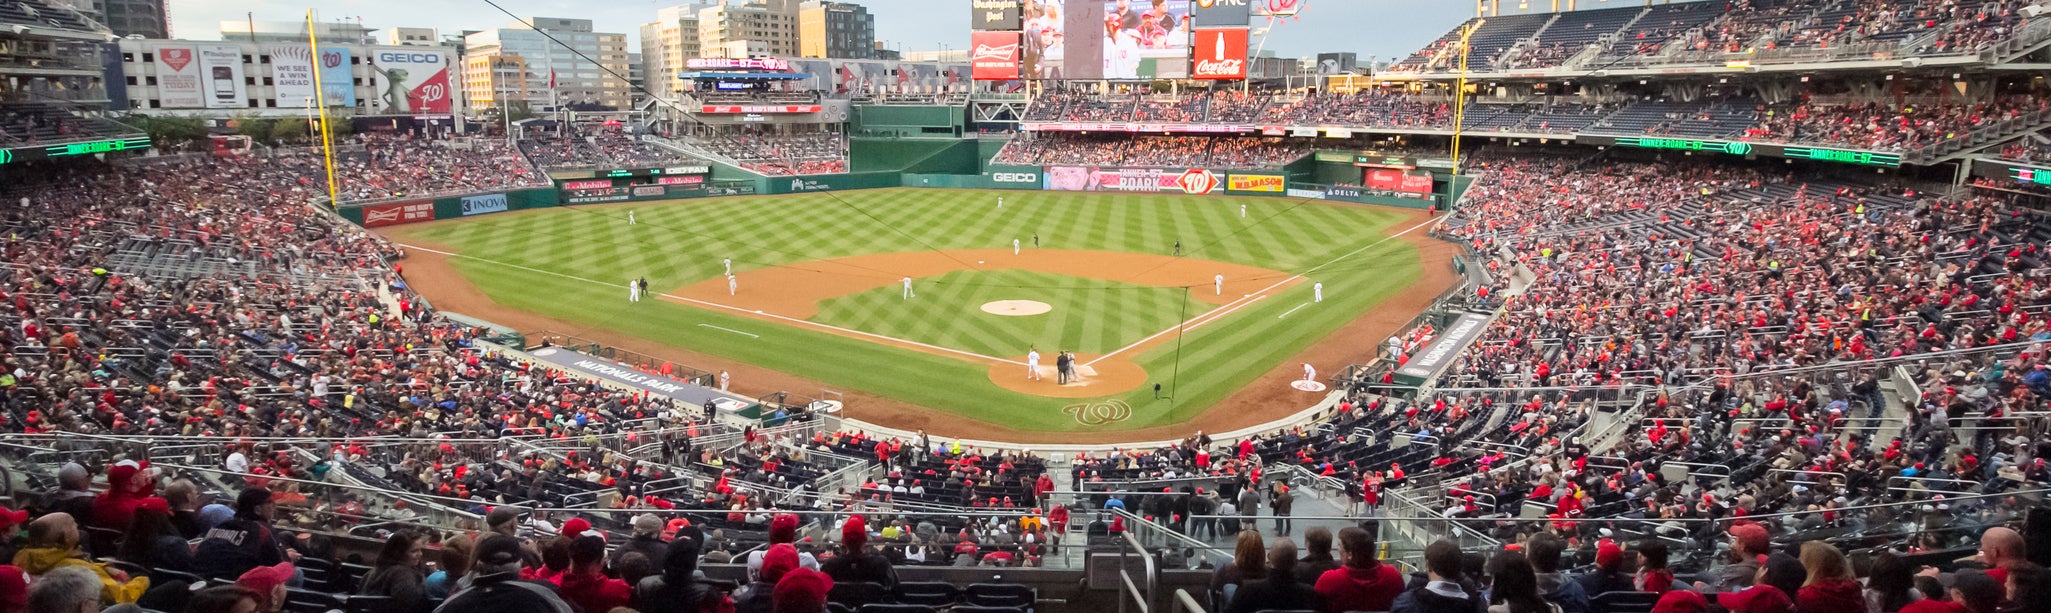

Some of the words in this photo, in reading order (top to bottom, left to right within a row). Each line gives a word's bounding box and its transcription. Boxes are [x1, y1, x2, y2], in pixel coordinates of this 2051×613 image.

[380, 53, 439, 63] GEICO
[1195, 59, 1242, 75] Coca-Cola
[1692, 141, 1703, 150] 57
[1860, 153, 1872, 163] 57
[993, 172, 1036, 183] GEICO
[1119, 169, 1146, 178] TANNER
[1120, 178, 1160, 191] ROARK
[1335, 189, 1359, 197] DELTA
[473, 198, 507, 209] INOVA
[574, 360, 647, 383] NATIONALS
[641, 379, 684, 393] PARK
